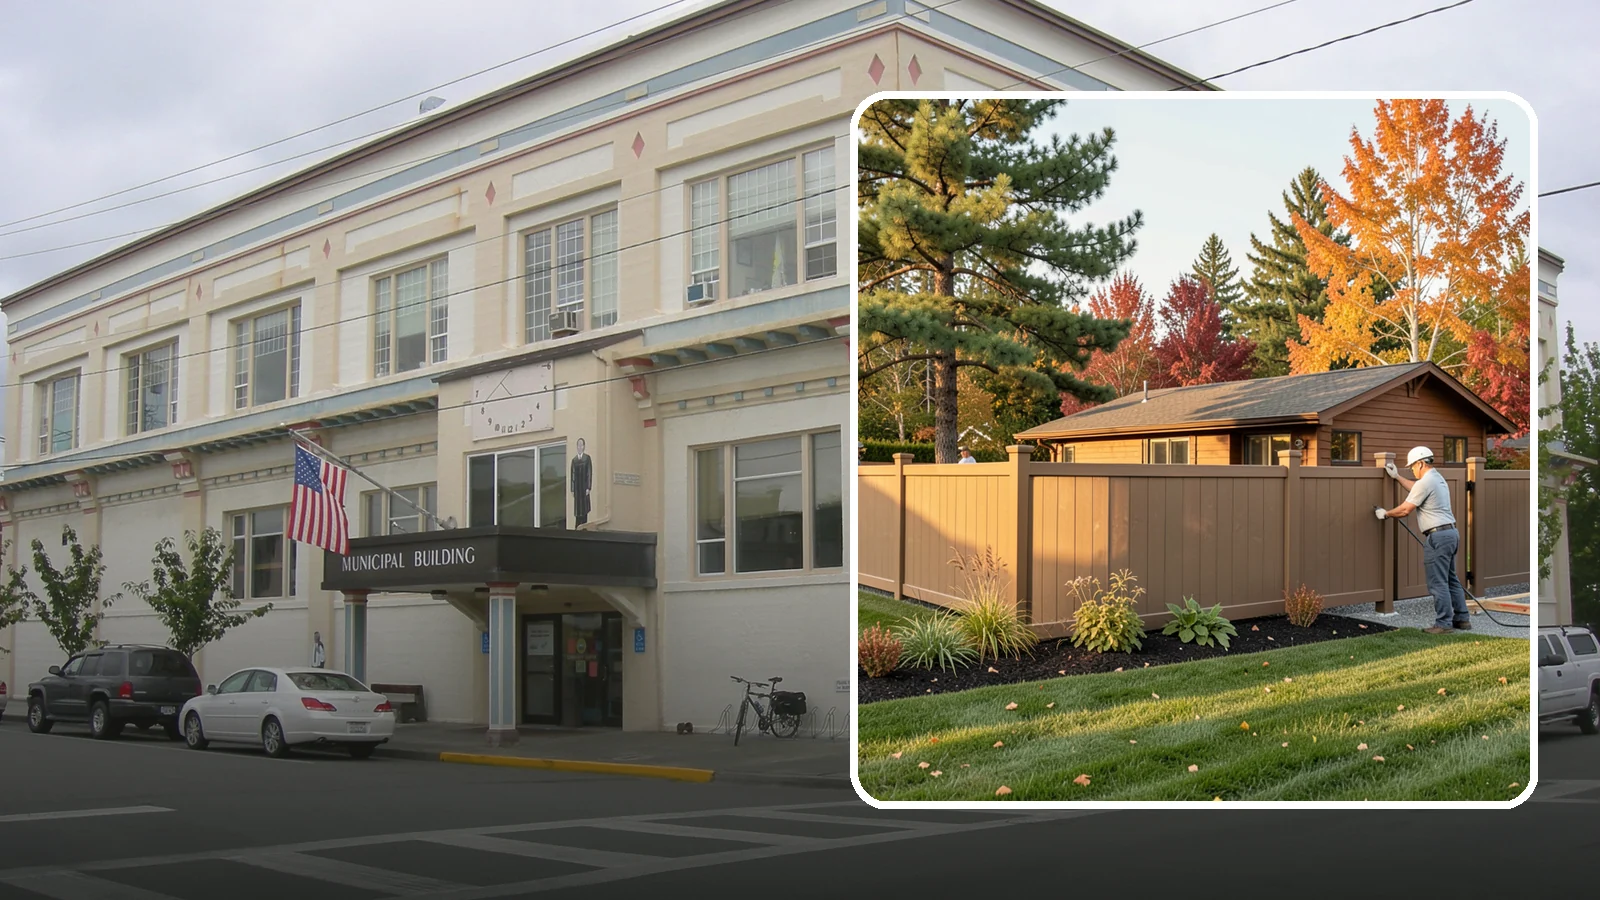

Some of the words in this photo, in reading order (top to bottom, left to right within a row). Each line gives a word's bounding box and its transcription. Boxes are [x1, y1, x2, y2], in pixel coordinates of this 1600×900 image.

[480, 407, 484, 415] 8
[495, 424, 500, 432] 10
[342, 552, 405, 572] MUNICIPAL
[414, 546, 475, 567] BUILDING
